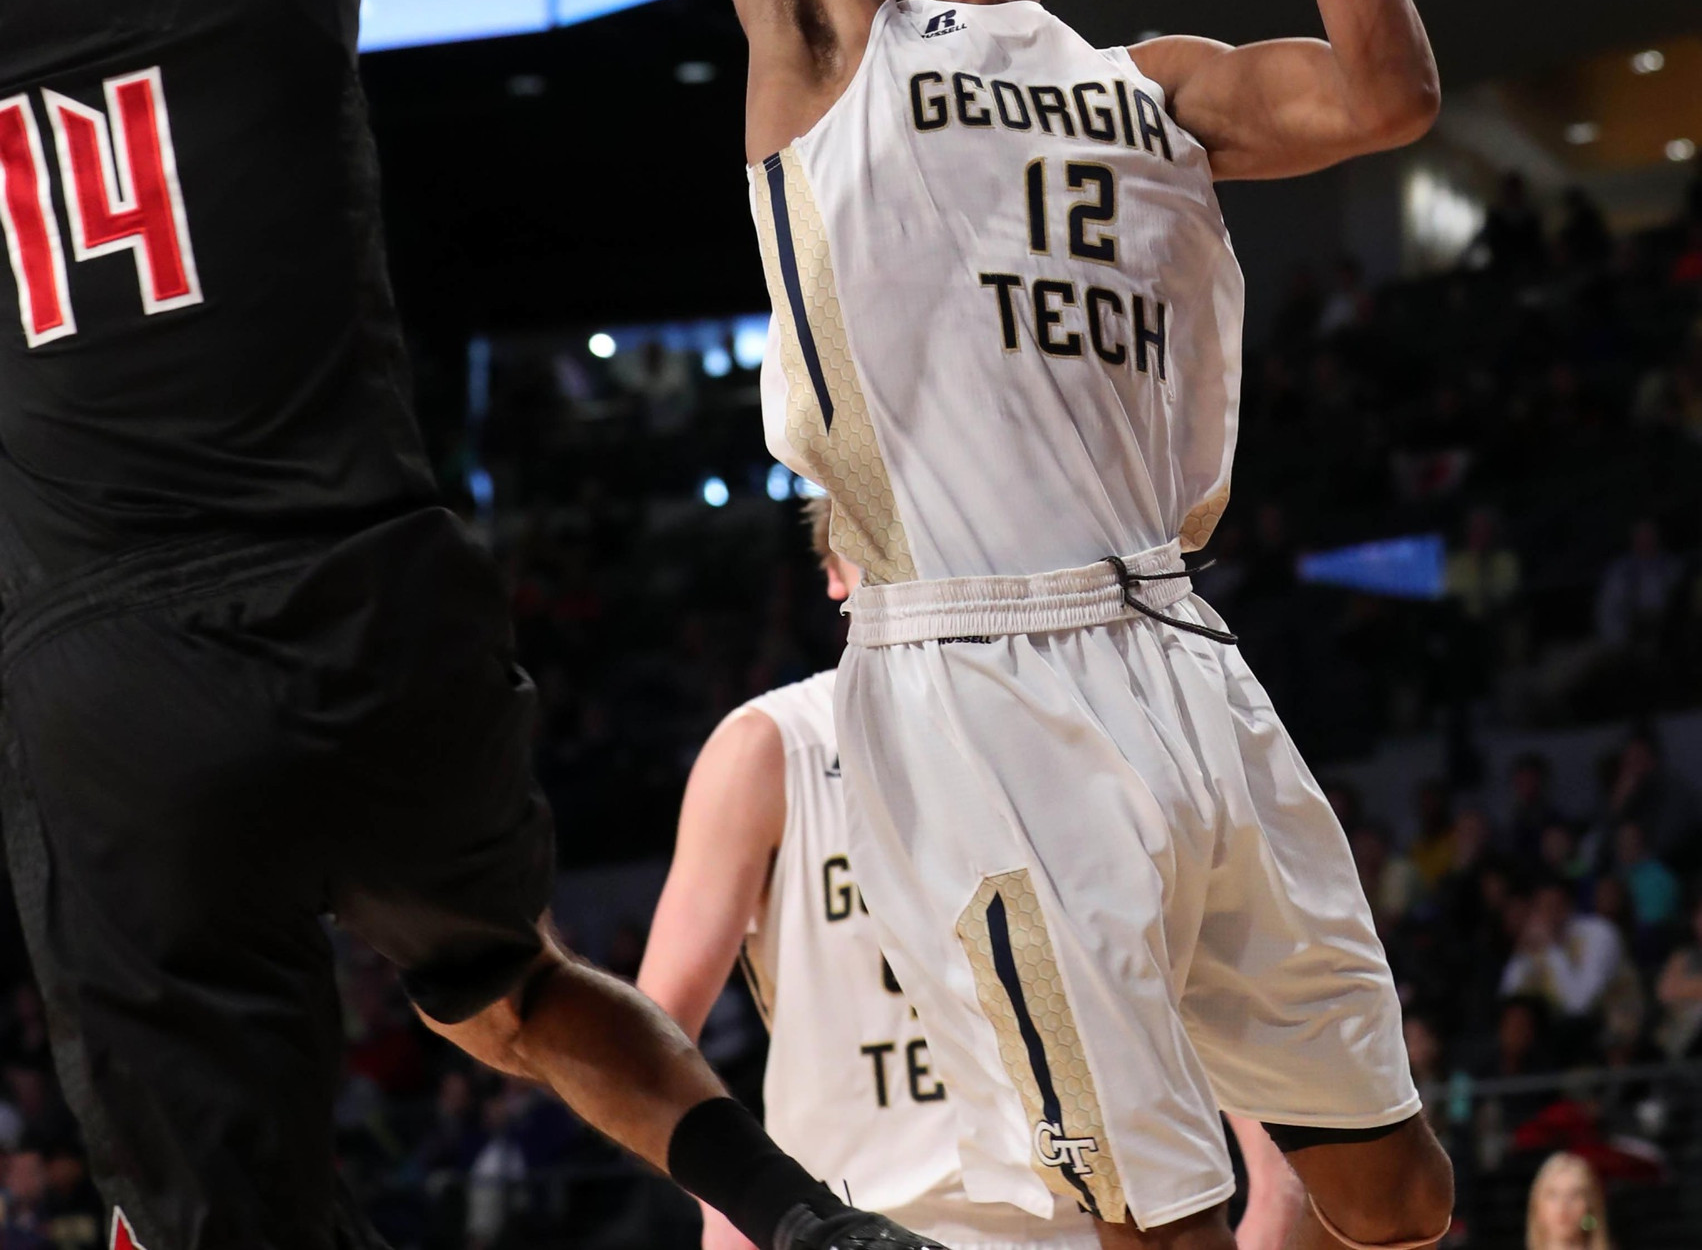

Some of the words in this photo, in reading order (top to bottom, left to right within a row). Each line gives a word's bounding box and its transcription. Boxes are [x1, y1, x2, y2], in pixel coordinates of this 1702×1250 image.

[909, 70, 1175, 163] GEORGIA
[0, 65, 204, 349] 14
[1024, 155, 1120, 265] 12
[979, 271, 1168, 385] TECH
